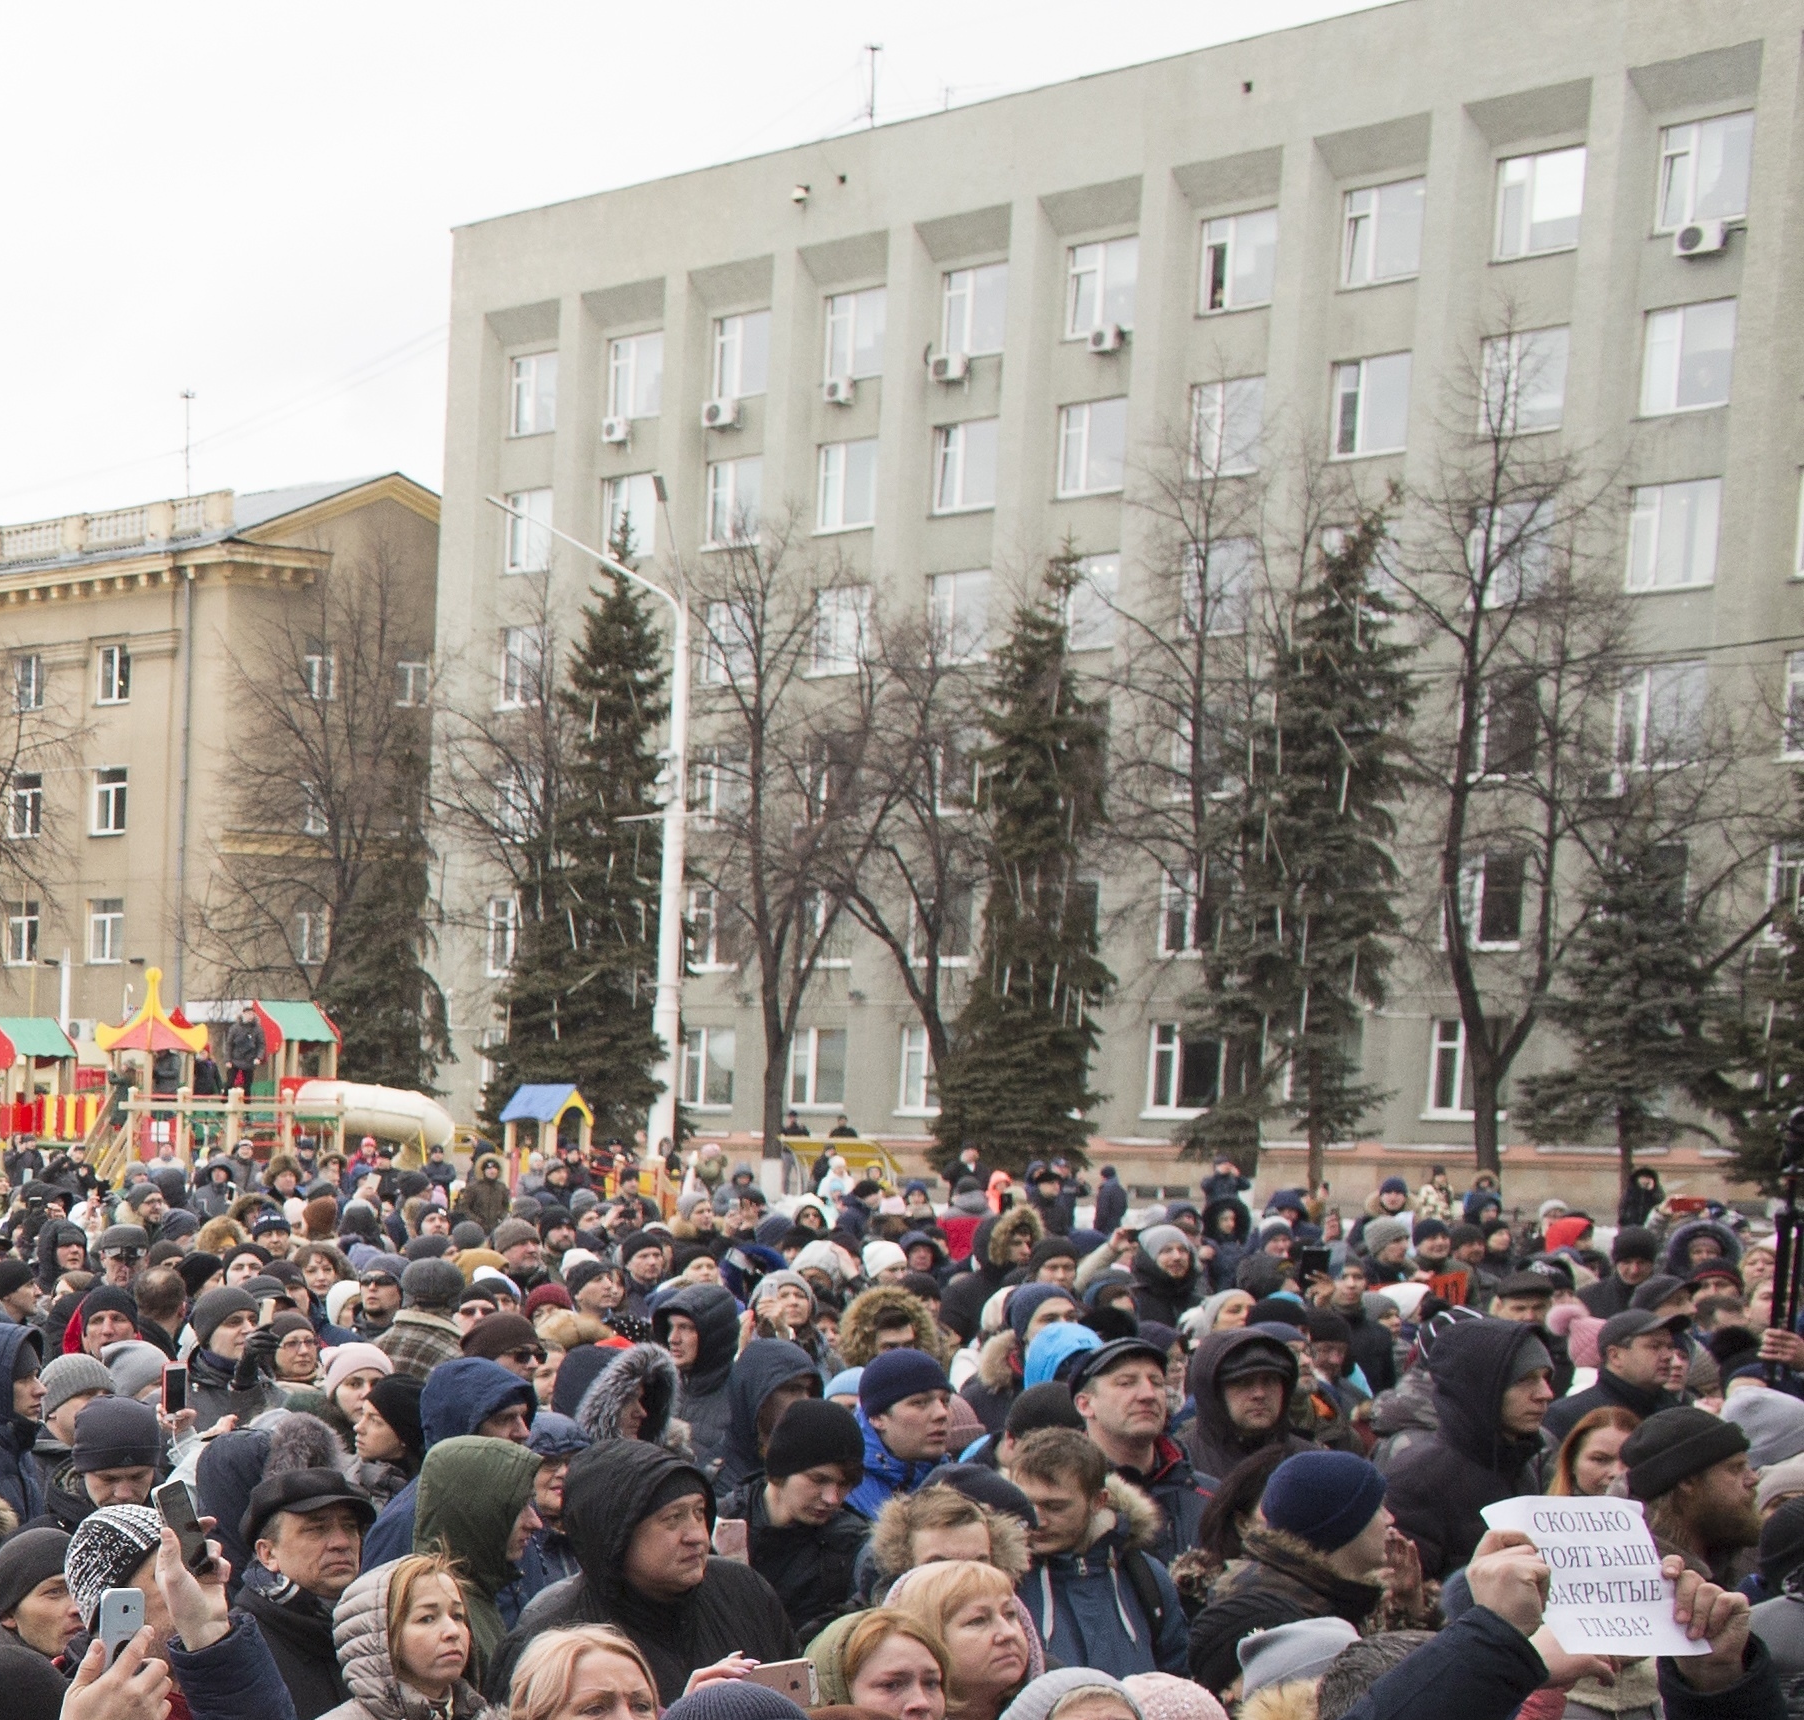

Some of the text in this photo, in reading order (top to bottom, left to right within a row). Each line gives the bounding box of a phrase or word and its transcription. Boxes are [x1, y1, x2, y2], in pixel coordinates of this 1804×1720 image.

[1533, 1511, 1631, 1533] СКОЛЬКО
[1539, 1546, 1593, 1569] ТОЯТ
[1549, 1579, 1662, 1605] ЗАКРЫТЫЕ
[1578, 1616, 1652, 1637] ГЛАЗА?
